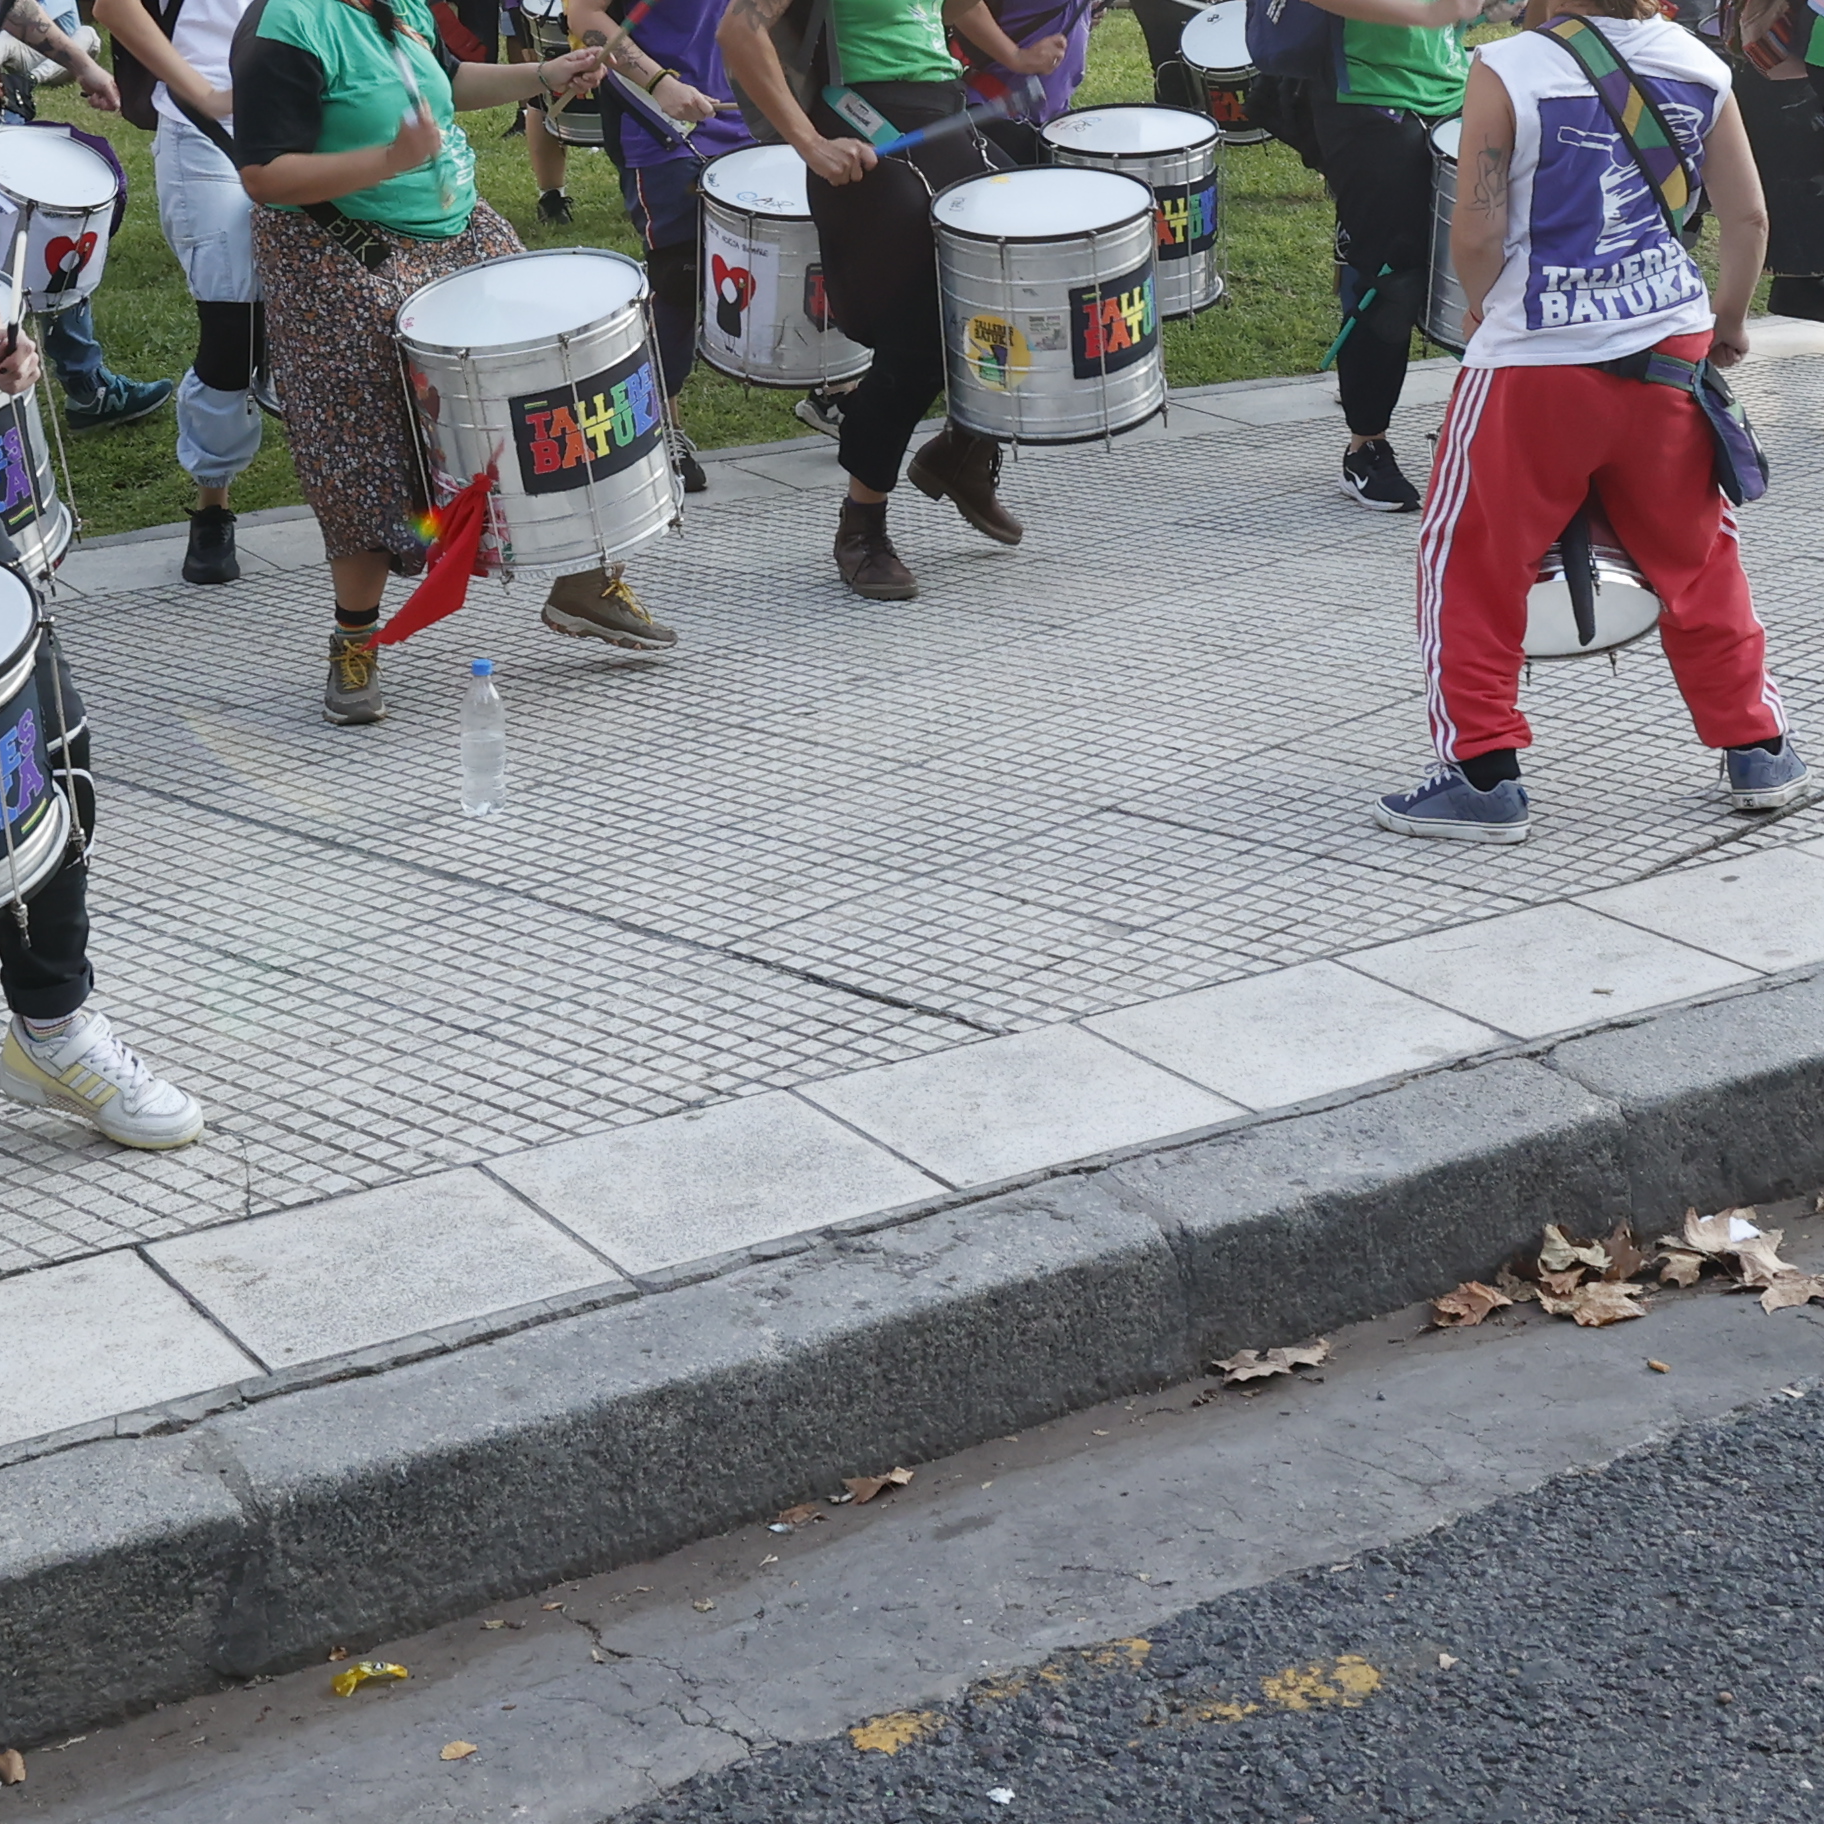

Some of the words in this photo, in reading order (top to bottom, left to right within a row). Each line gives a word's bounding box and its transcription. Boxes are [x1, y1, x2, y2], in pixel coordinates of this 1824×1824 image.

[327, 216, 379, 263] BTK
[1539, 261, 1703, 327] BATUKA
[1083, 299, 1158, 359] BATU
[525, 361, 656, 440] TALLERE
